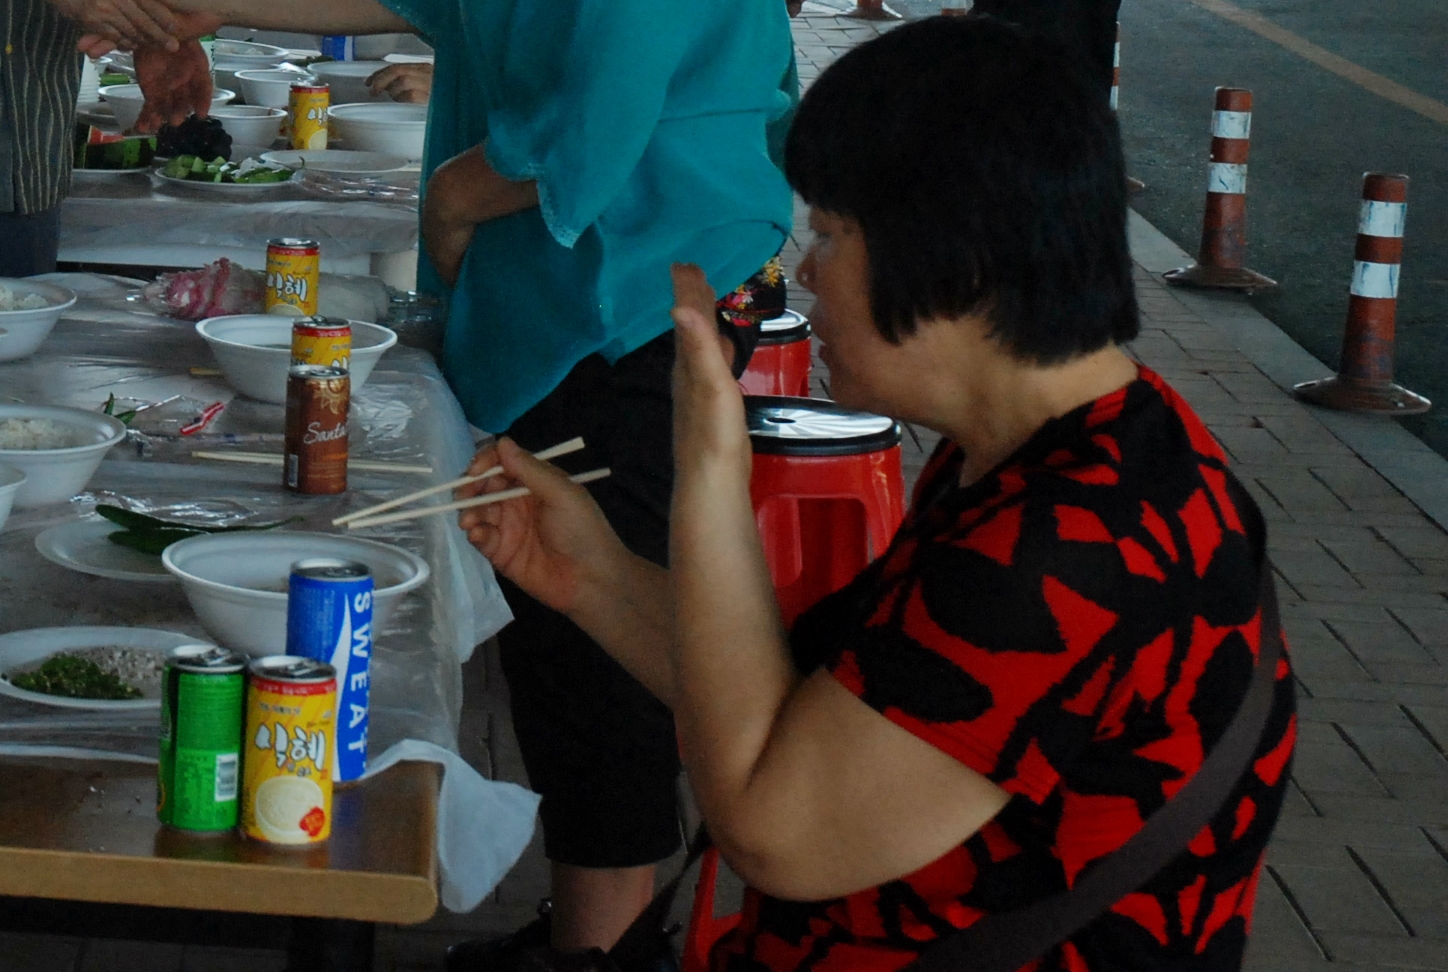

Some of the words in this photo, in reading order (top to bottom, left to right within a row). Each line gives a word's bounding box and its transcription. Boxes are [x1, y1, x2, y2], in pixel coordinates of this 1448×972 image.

[303, 421, 347, 444] Santa
[348, 591, 371, 754] SWEAT
[254, 720, 326, 772] 식혜
